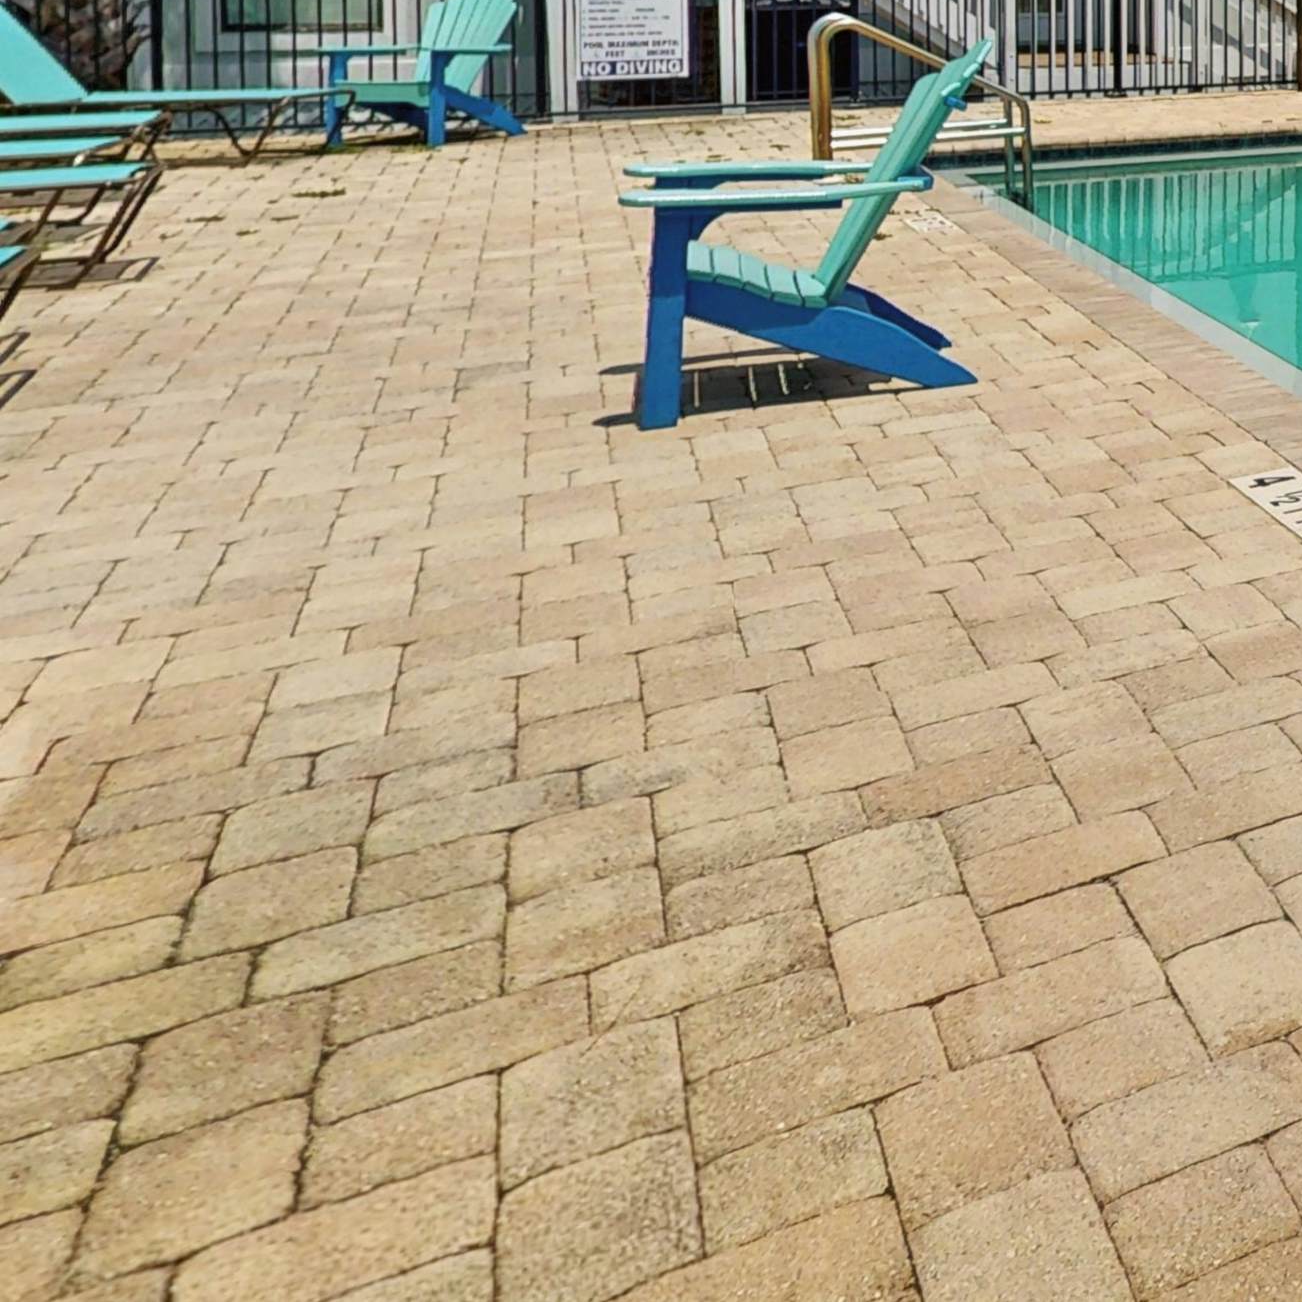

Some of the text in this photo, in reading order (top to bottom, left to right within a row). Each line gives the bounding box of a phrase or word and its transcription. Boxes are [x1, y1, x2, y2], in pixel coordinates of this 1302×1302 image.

[583, 60, 681, 75] NO DIVING
[1249, 475, 1296, 489] 4
